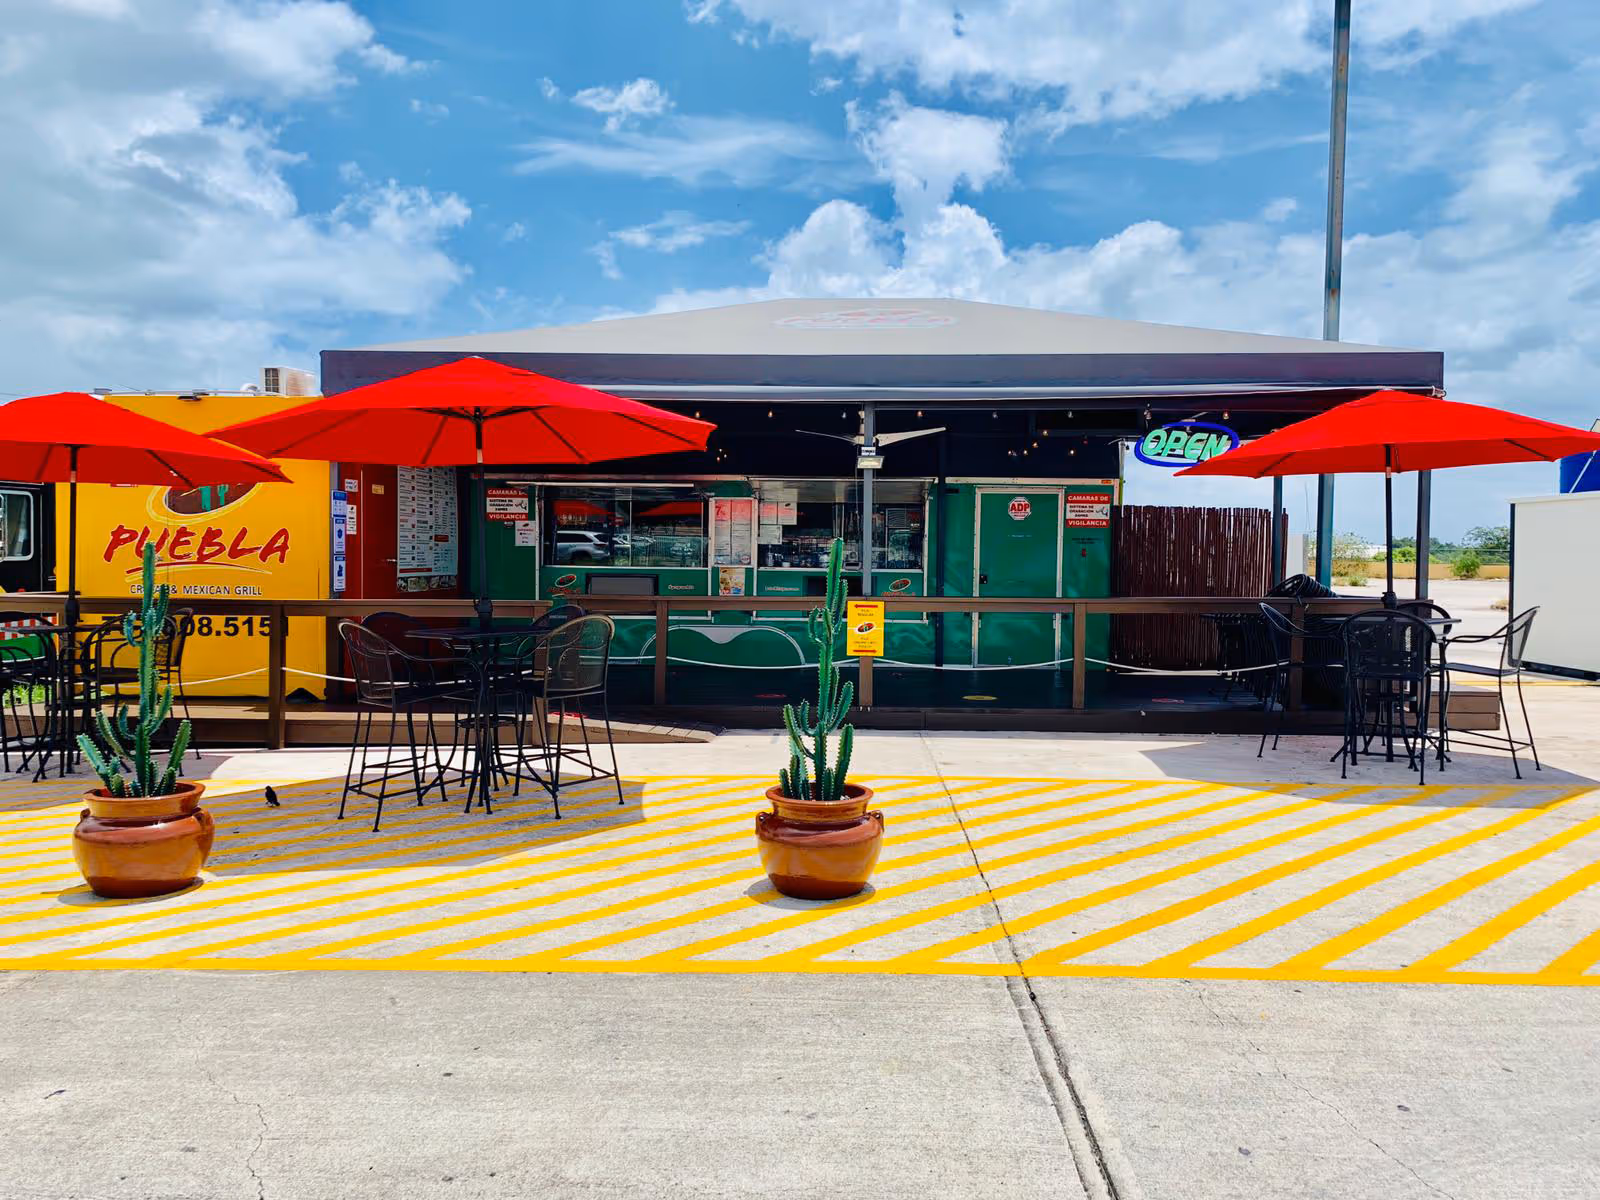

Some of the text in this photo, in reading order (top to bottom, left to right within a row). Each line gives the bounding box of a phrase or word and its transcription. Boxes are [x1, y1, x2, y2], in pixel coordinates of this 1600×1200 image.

[1142, 429, 1229, 461] OPEN
[1010, 503, 1030, 512] ADP
[103, 525, 290, 563] PUEBLA
[171, 585, 177, 595] &
[183, 585, 231, 595] MEXICAN
[234, 586, 263, 596] GRILL
